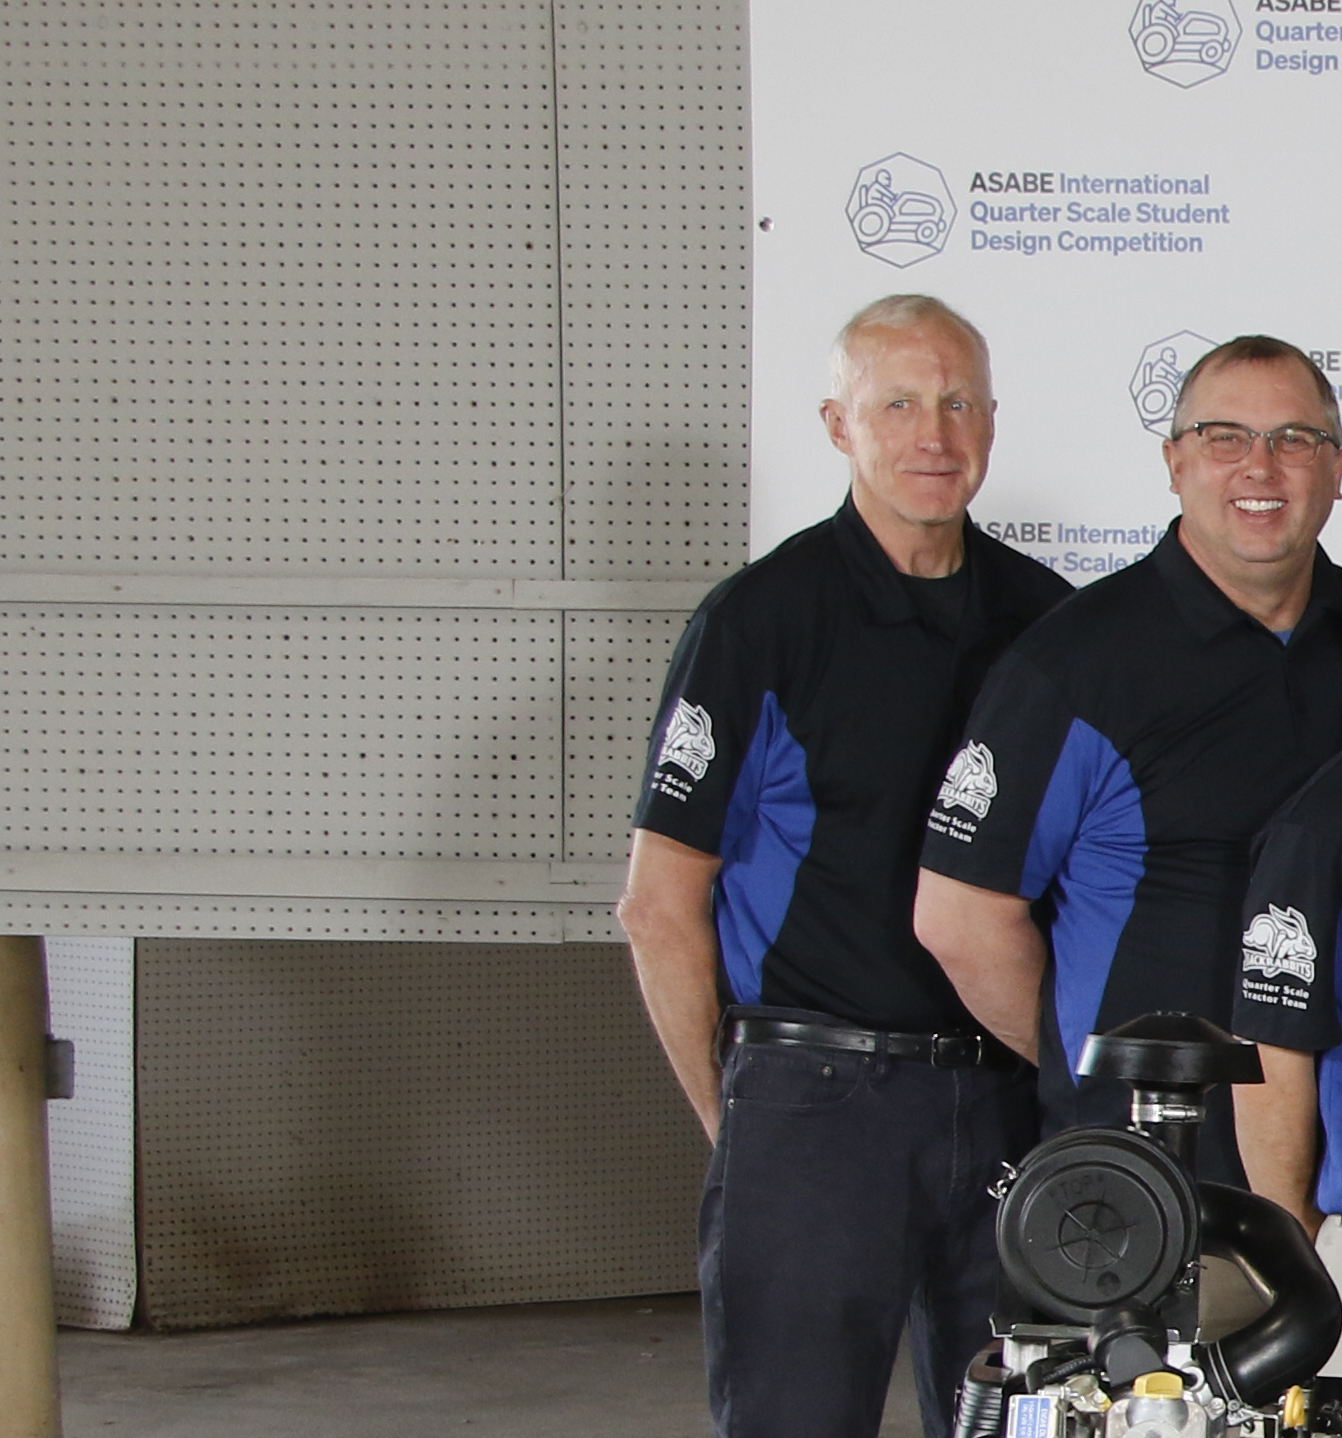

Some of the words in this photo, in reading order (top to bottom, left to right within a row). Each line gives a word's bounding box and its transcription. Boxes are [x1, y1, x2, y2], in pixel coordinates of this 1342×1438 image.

[1256, 50, 1338, 75] Design
[970, 171, 1054, 194] ASABE
[1060, 172, 1209, 195] International
[970, 201, 1061, 225] Quarter
[1067, 202, 1131, 224] Scale
[1137, 202, 1229, 224] Student
[971, 230, 1051, 255] Design
[1058, 231, 1202, 256] Competition
[1063, 551, 1131, 573] Scale
[952, 817, 977, 834] Scale
[1242, 978, 1280, 993] Quarter
[1282, 985, 1310, 1000] Scale
[1242, 989, 1279, 1004] Tractor
[1281, 996, 1307, 1010] Team
